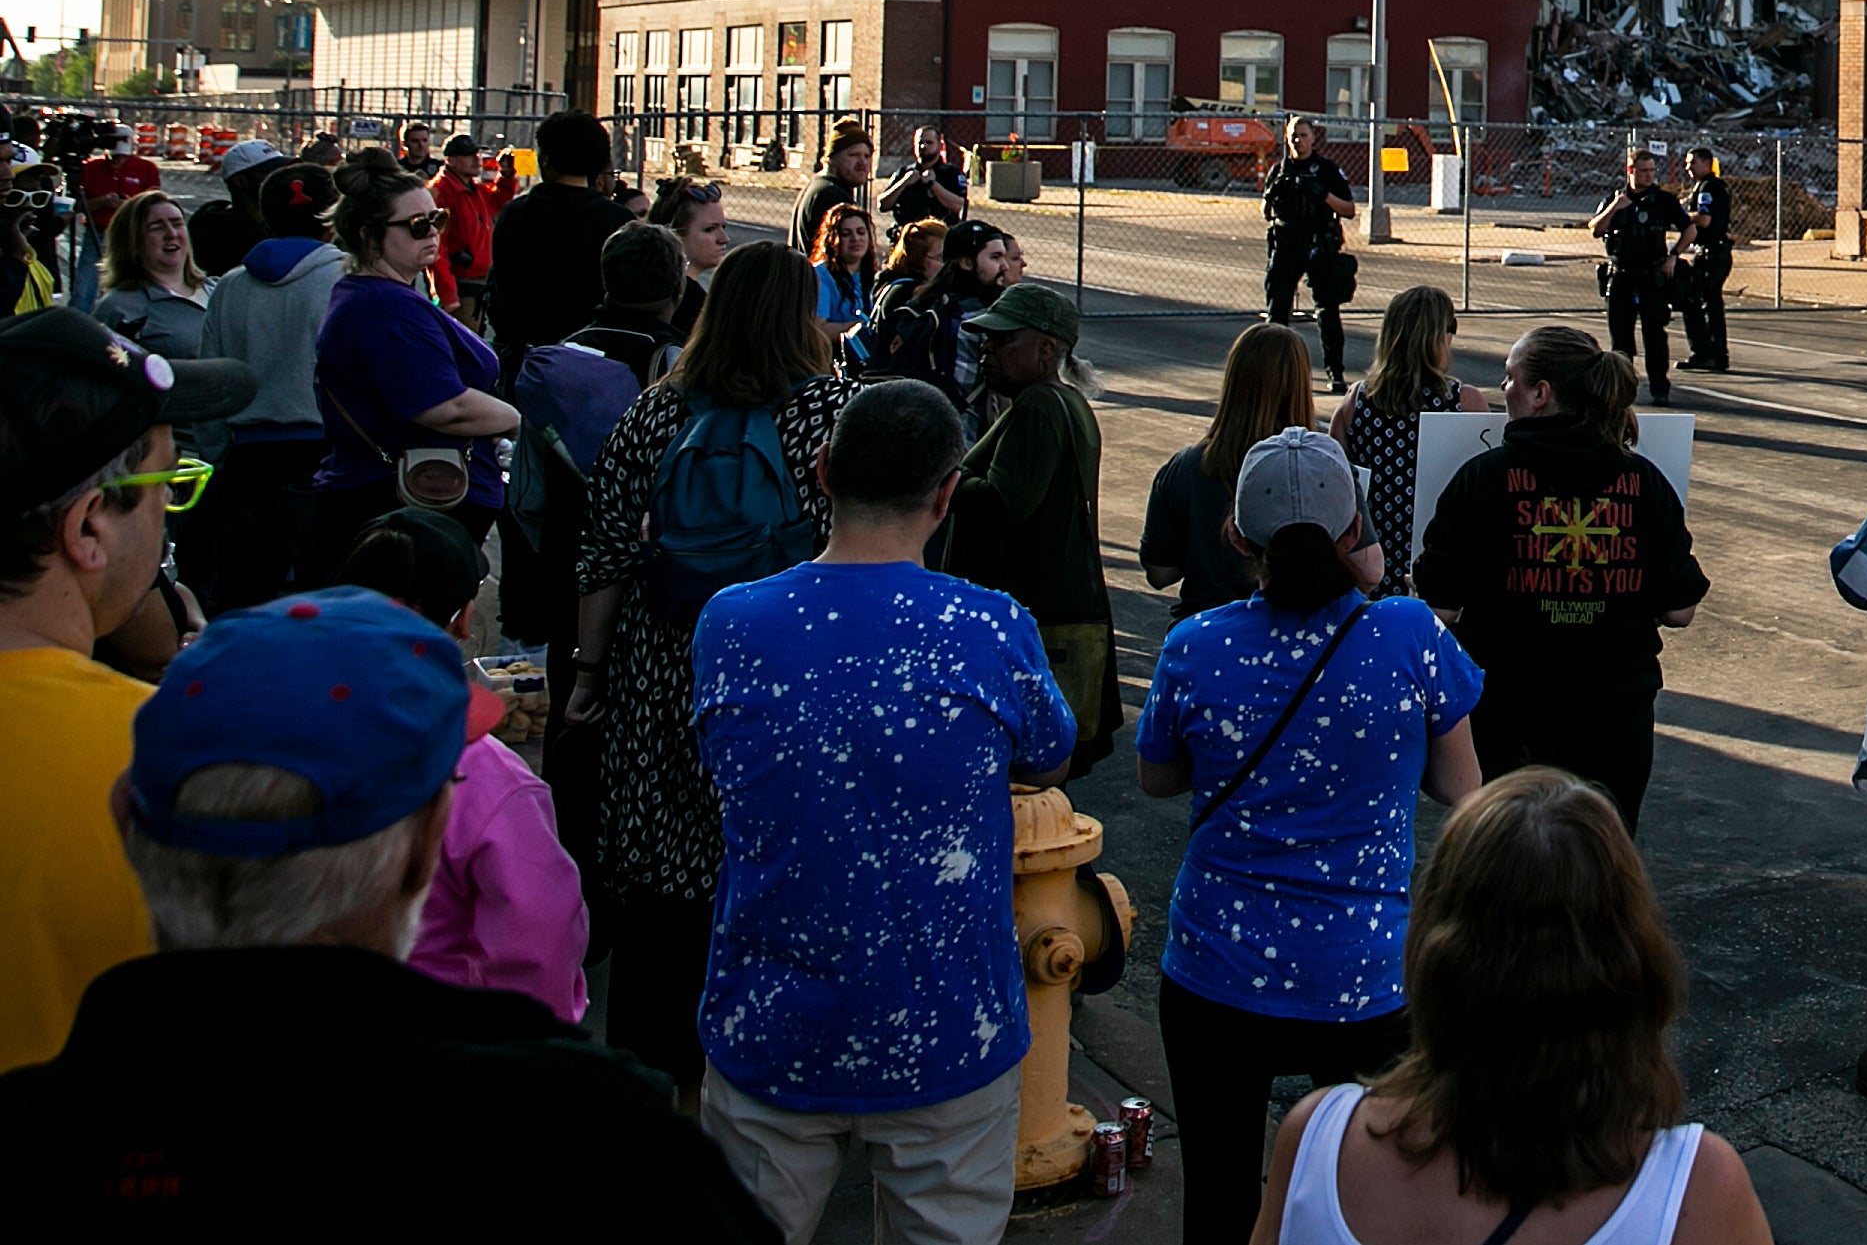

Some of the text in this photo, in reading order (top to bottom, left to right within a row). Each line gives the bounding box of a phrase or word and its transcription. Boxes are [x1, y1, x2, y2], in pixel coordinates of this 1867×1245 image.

[1507, 467, 1641, 498] NO AN
[1590, 501, 1634, 528] YOU
[1512, 534, 1638, 561] THE CHAOS
[1506, 566, 1644, 594] AWAITS YOU
[1541, 599, 1606, 613] HOLLYWOOD
[1550, 610, 1594, 624] UNDEAD
